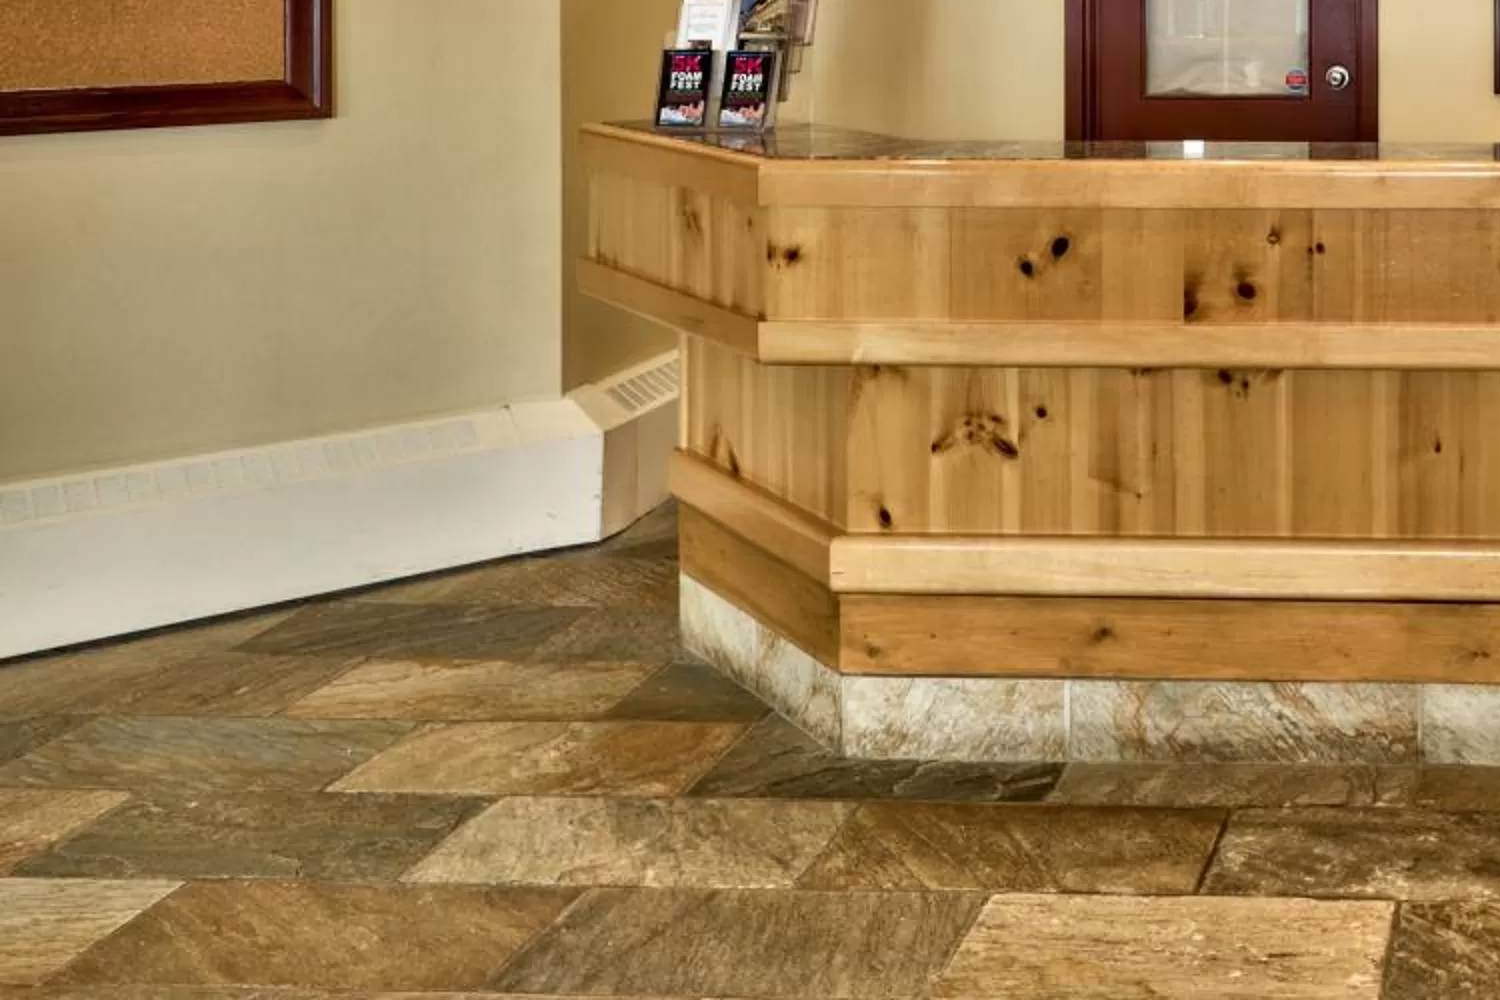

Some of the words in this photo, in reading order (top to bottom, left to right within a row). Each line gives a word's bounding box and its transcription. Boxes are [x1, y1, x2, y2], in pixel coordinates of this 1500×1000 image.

[672, 55, 702, 73] 5K
[735, 56, 763, 74] 5K
[670, 71, 703, 82] FOAM
[732, 73, 764, 84] FOAM
[669, 80, 700, 90] FEST
[731, 81, 762, 92] FEST
